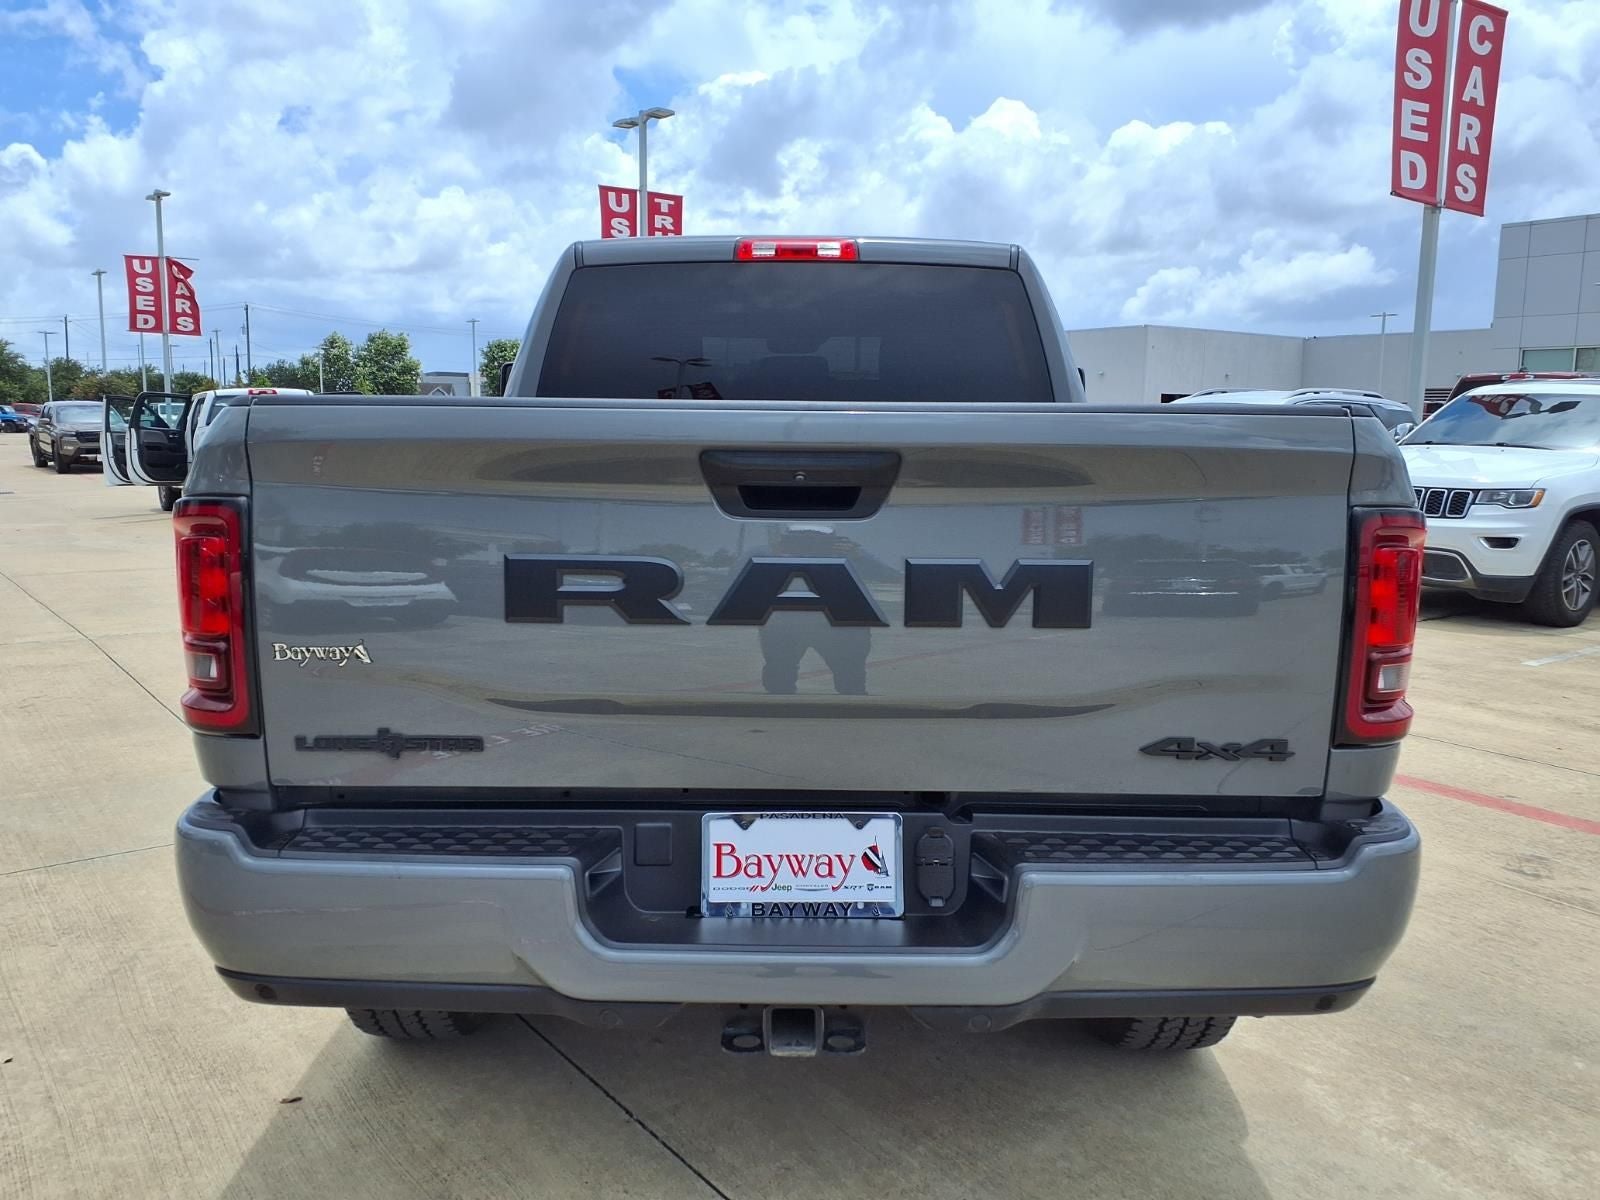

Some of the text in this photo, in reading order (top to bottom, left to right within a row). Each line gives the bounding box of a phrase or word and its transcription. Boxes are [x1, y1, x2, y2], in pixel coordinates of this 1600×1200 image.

[1400, 0, 1440, 190] USED
[1454, 15, 1495, 203] CARS
[654, 198, 675, 237] TR
[132, 259, 156, 329] USED
[504, 554, 1093, 628] RAM
[272, 642, 354, 667] Bayway
[760, 812, 845, 820] PASADENA
[712, 842, 856, 892] Bayway
[771, 883, 793, 892] Jeep
[751, 902, 853, 917] BAYWAY
